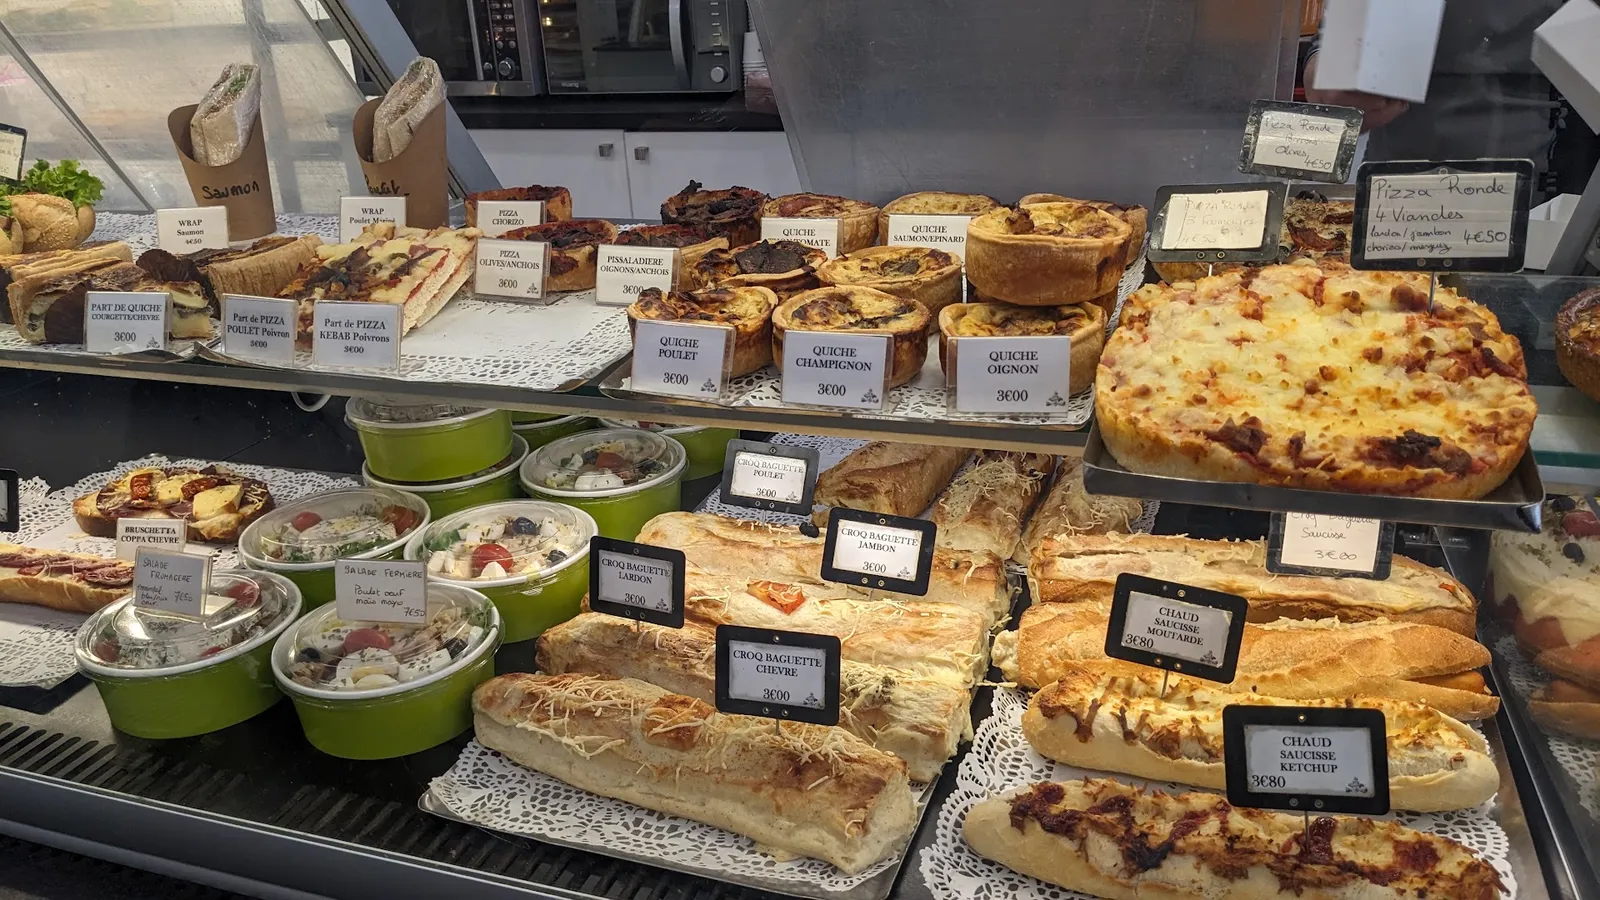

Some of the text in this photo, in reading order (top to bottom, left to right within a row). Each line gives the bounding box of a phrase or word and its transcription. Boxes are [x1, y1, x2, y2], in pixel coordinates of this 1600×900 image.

[1300, 118, 1334, 134] Ronde
[1275, 145, 1306, 156] Olives
[202, 181, 260, 200] Saumon
[1372, 174, 1510, 200] Pizza Ronde
[1376, 204, 1464, 222] 4 Viandes
[492, 218, 524, 226] CHORIZO
[782, 228, 816, 236] QUICHE
[912, 225, 948, 234] QUICHE
[893, 234, 964, 244] SAUMON/EPINARD
[1464, 230, 1507, 244] 4€50
[500, 250, 520, 258] PIZZA
[480, 258, 540, 270] OLIVES/ANCHOIS
[607, 256, 664, 266] PISSALADIERE
[600, 265, 670, 276] OIGNONS/ANCHOIS
[498, 278, 518, 288] 3€00
[622, 284, 644, 294] 3€00
[91, 304, 162, 312] PART DE QUICHE
[233, 313, 285, 326] Part de PIZZA
[324, 318, 386, 330] Part de PIZZA
[114, 332, 136, 342] 3€00
[227, 324, 290, 338] POULET Poivron
[320, 330, 390, 342] KEBAB Poivrons
[250, 340, 268, 348] 3€00
[660, 336, 699, 348] QUICHE
[344, 345, 364, 354] 3€00
[658, 348, 698, 360] POULET
[812, 346, 857, 357] QUICHE
[989, 351, 1039, 362] QUICHE
[796, 358, 872, 371] CHAMPIGNON
[987, 364, 1039, 374] OIGNON
[663, 372, 689, 385] 3€00
[818, 383, 846, 396] 3€00
[996, 390, 1028, 402] 3€00
[737, 458, 804, 474] CROQ BAGUETTE
[753, 469, 785, 480] POULET
[756, 487, 776, 498] 3€00
[125, 526, 176, 535] BRUSCHETTA
[1301, 527, 1346, 539] Saucisse
[121, 535, 180, 544] COPPA CHEVRE
[841, 528, 919, 546] CROQ BAGUETTE
[858, 541, 896, 553] JAMBON
[143, 557, 170, 570] SALADE
[602, 558, 670, 577] CROQ BAGUETTE
[862, 561, 887, 573] 3€00
[344, 565, 424, 579] SALADE FERMIERE
[618, 571, 652, 584] LARDON
[354, 584, 380, 597] Poulet
[381, 599, 403, 608] mayo
[625, 592, 646, 606] 3€00
[1159, 606, 1200, 622] CHAUD
[1154, 617, 1200, 634] SAUCISSE
[1125, 633, 1154, 649] 3€80
[1146, 626, 1204, 646] MOUTARDE
[733, 650, 822, 667] CROQ BAGUETTE
[756, 664, 798, 677] CHEVRE
[763, 688, 790, 702] 3€00
[1282, 736, 1332, 748] CHAUD
[1280, 750, 1336, 761] SAUCISSE
[1280, 762, 1338, 773] KETCHUP
[1252, 774, 1286, 788] 3€80
